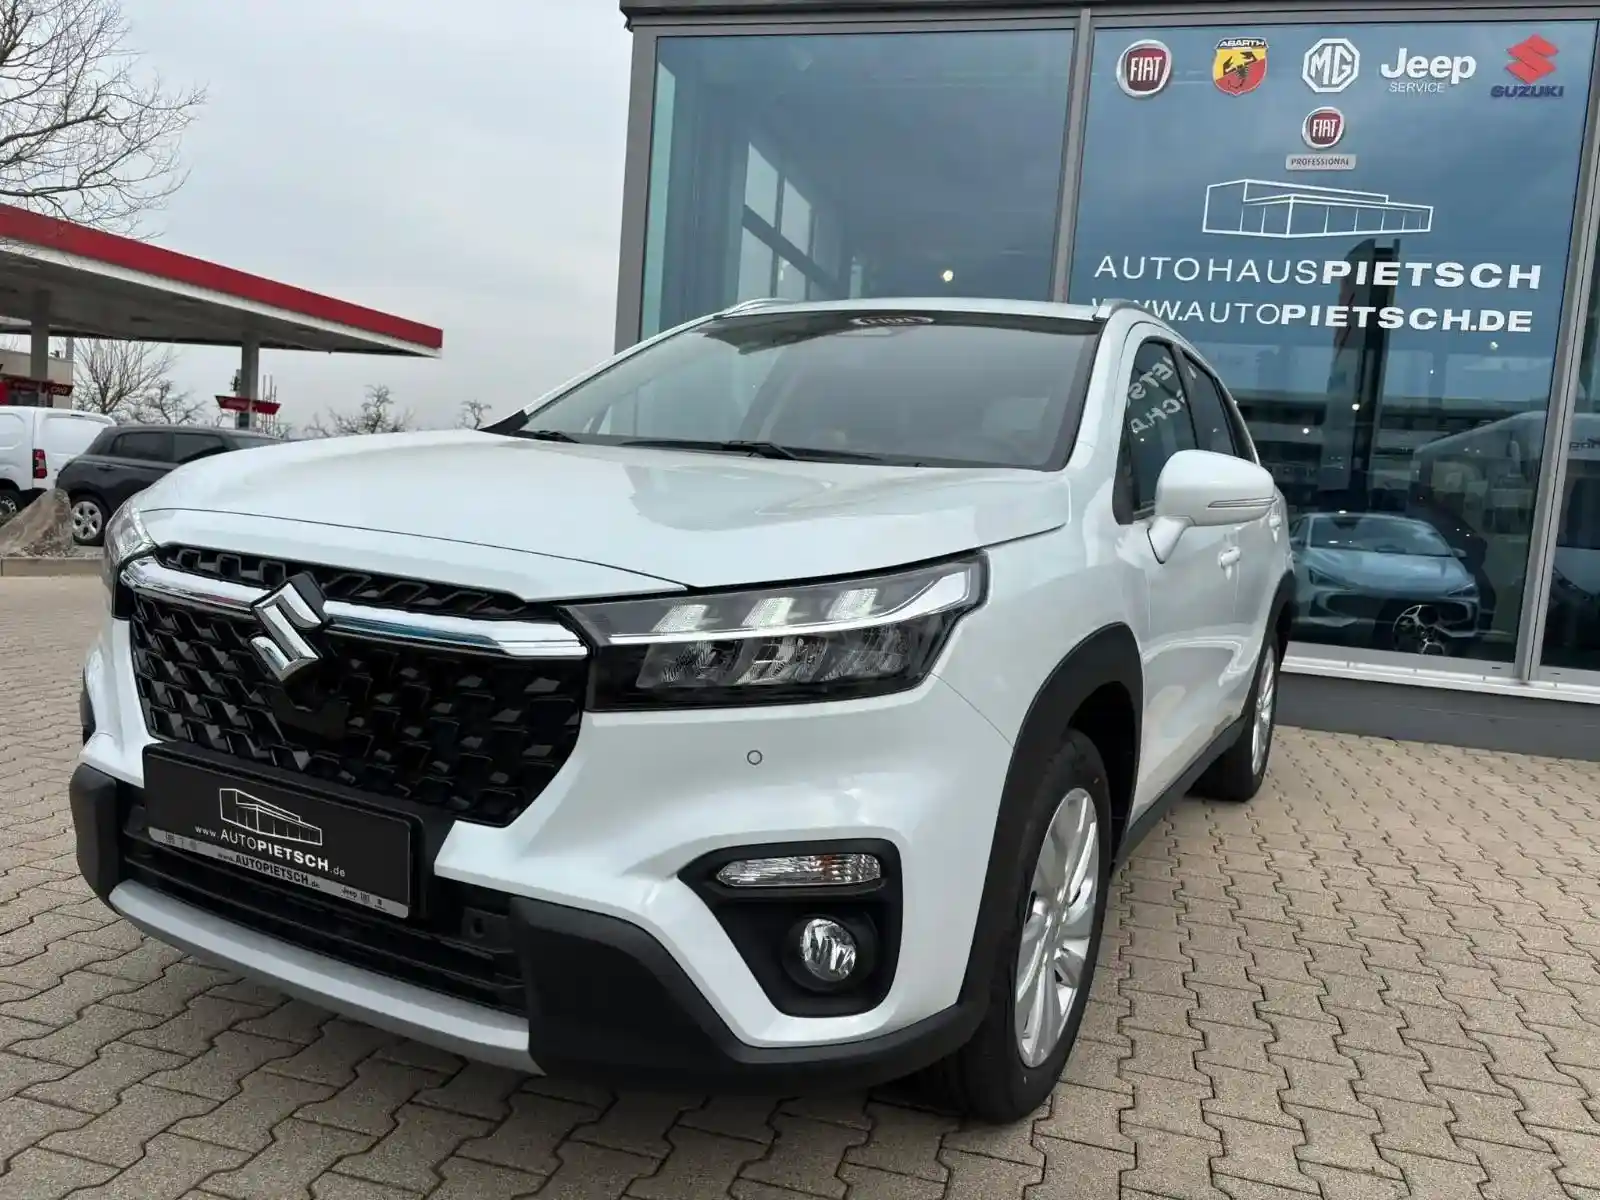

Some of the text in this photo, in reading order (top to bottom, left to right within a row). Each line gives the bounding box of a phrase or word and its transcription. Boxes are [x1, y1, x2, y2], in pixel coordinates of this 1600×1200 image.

[1219, 39, 1265, 47] ABARTH
[1129, 56, 1163, 82] FIAT
[1310, 45, 1352, 85] MG
[1381, 48, 1477, 84] Jeep
[1389, 82, 1445, 93] SERVICE
[1490, 85, 1564, 98] SUZUKI
[1312, 119, 1338, 138] FIAT
[1291, 157, 1349, 166] PROFESSIONAL
[1094, 255, 1542, 290] AUTOHAUSPIETSCH
[1092, 298, 1533, 333] W.AUTOPIETSCH.DE
